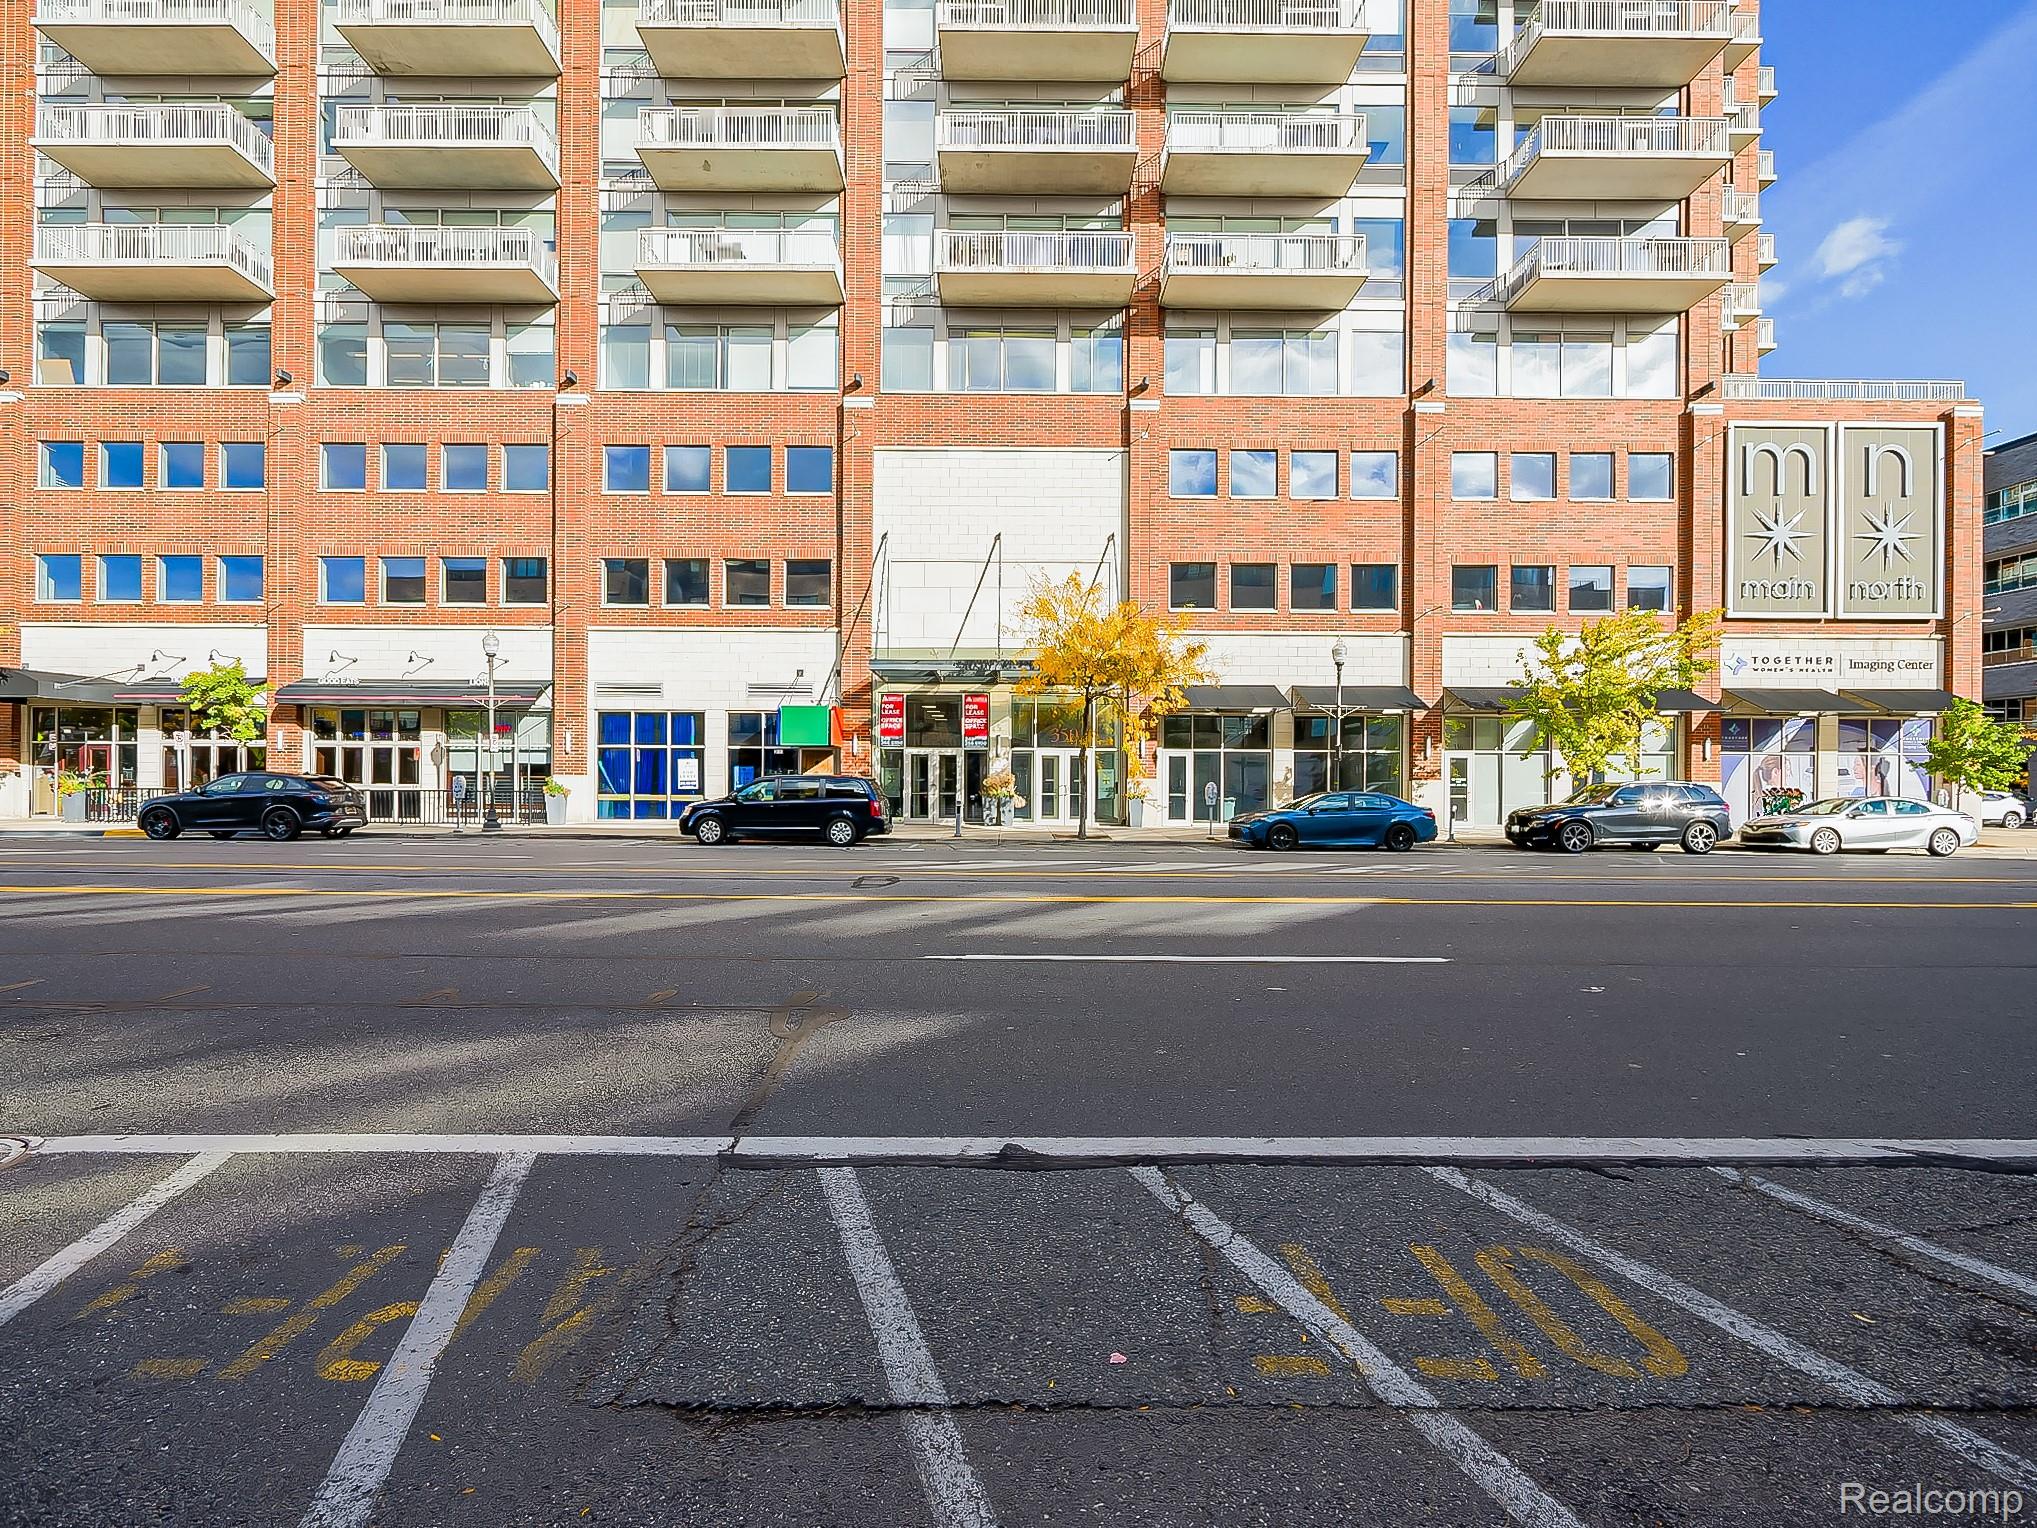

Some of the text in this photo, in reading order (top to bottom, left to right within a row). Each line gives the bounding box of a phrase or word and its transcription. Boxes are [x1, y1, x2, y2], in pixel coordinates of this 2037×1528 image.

[1742, 574, 1816, 599] main
[1852, 575, 1927, 600] north
[1751, 656, 1833, 665] TOGETHER
[1849, 659, 1934, 673] Imaging Center
